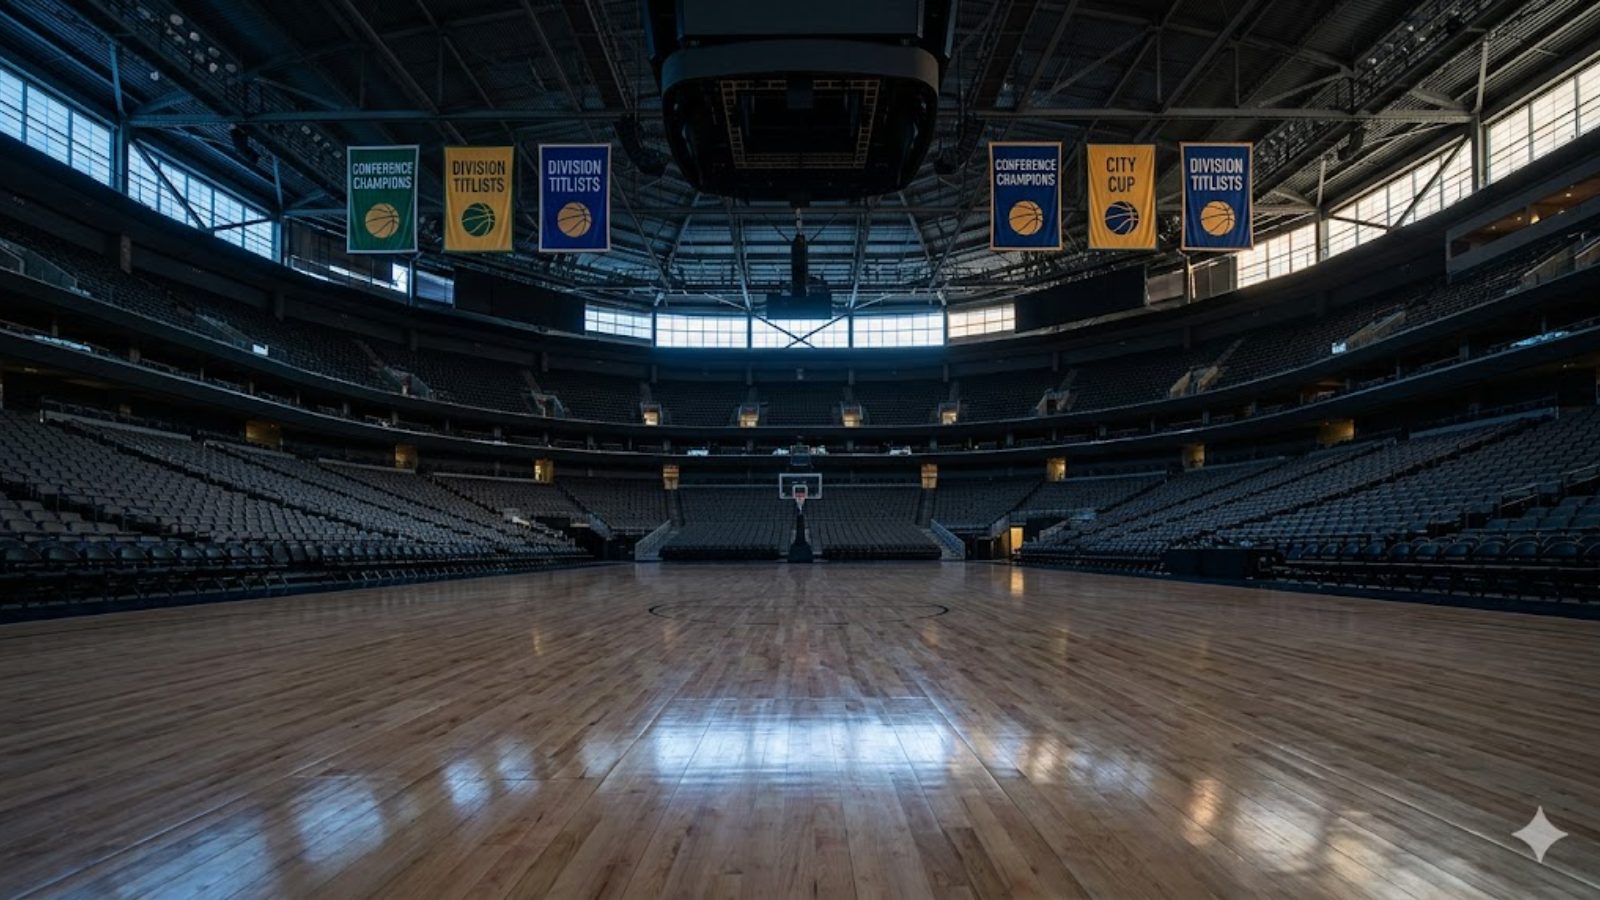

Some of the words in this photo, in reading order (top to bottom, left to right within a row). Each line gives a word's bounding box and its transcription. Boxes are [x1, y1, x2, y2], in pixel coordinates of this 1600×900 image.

[352, 162, 413, 175] CONFERENCE
[452, 160, 505, 176] DIVISION
[548, 160, 601, 175] DIVISION
[995, 158, 1057, 172] CONFERENCE
[1106, 157, 1137, 173] CITY
[1190, 157, 1243, 174] DIVISION
[353, 176, 412, 190] CHAMPIONS
[454, 177, 505, 193] TITLISTS
[549, 176, 601, 192] TITLISTS
[996, 173, 1056, 187] CHAMPIONS
[1108, 176, 1136, 193] CUP
[1191, 175, 1243, 191] TITLISTS
